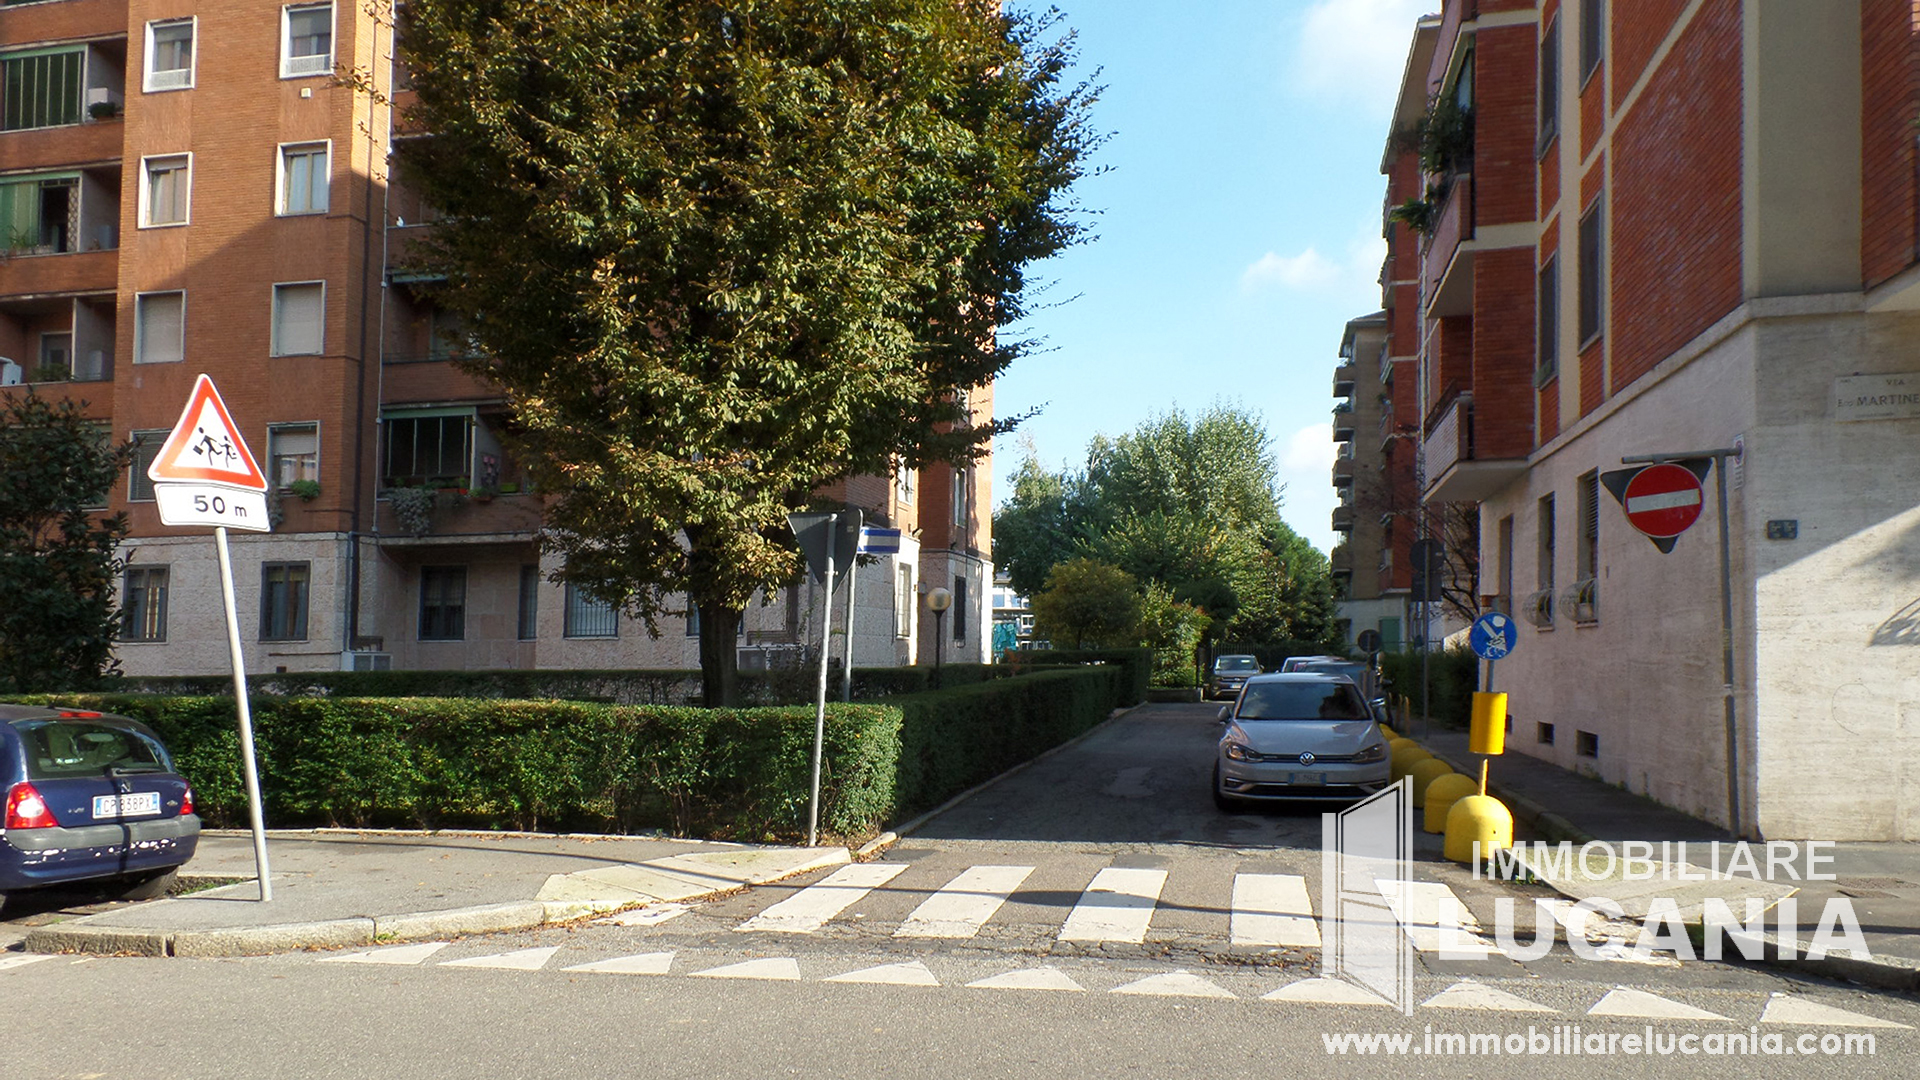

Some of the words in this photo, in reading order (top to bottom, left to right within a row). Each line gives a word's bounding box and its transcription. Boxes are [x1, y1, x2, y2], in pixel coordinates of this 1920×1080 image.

[1885, 378, 1905, 386] VIA
[194, 495, 226, 514] 50
[234, 505, 248, 518] m
